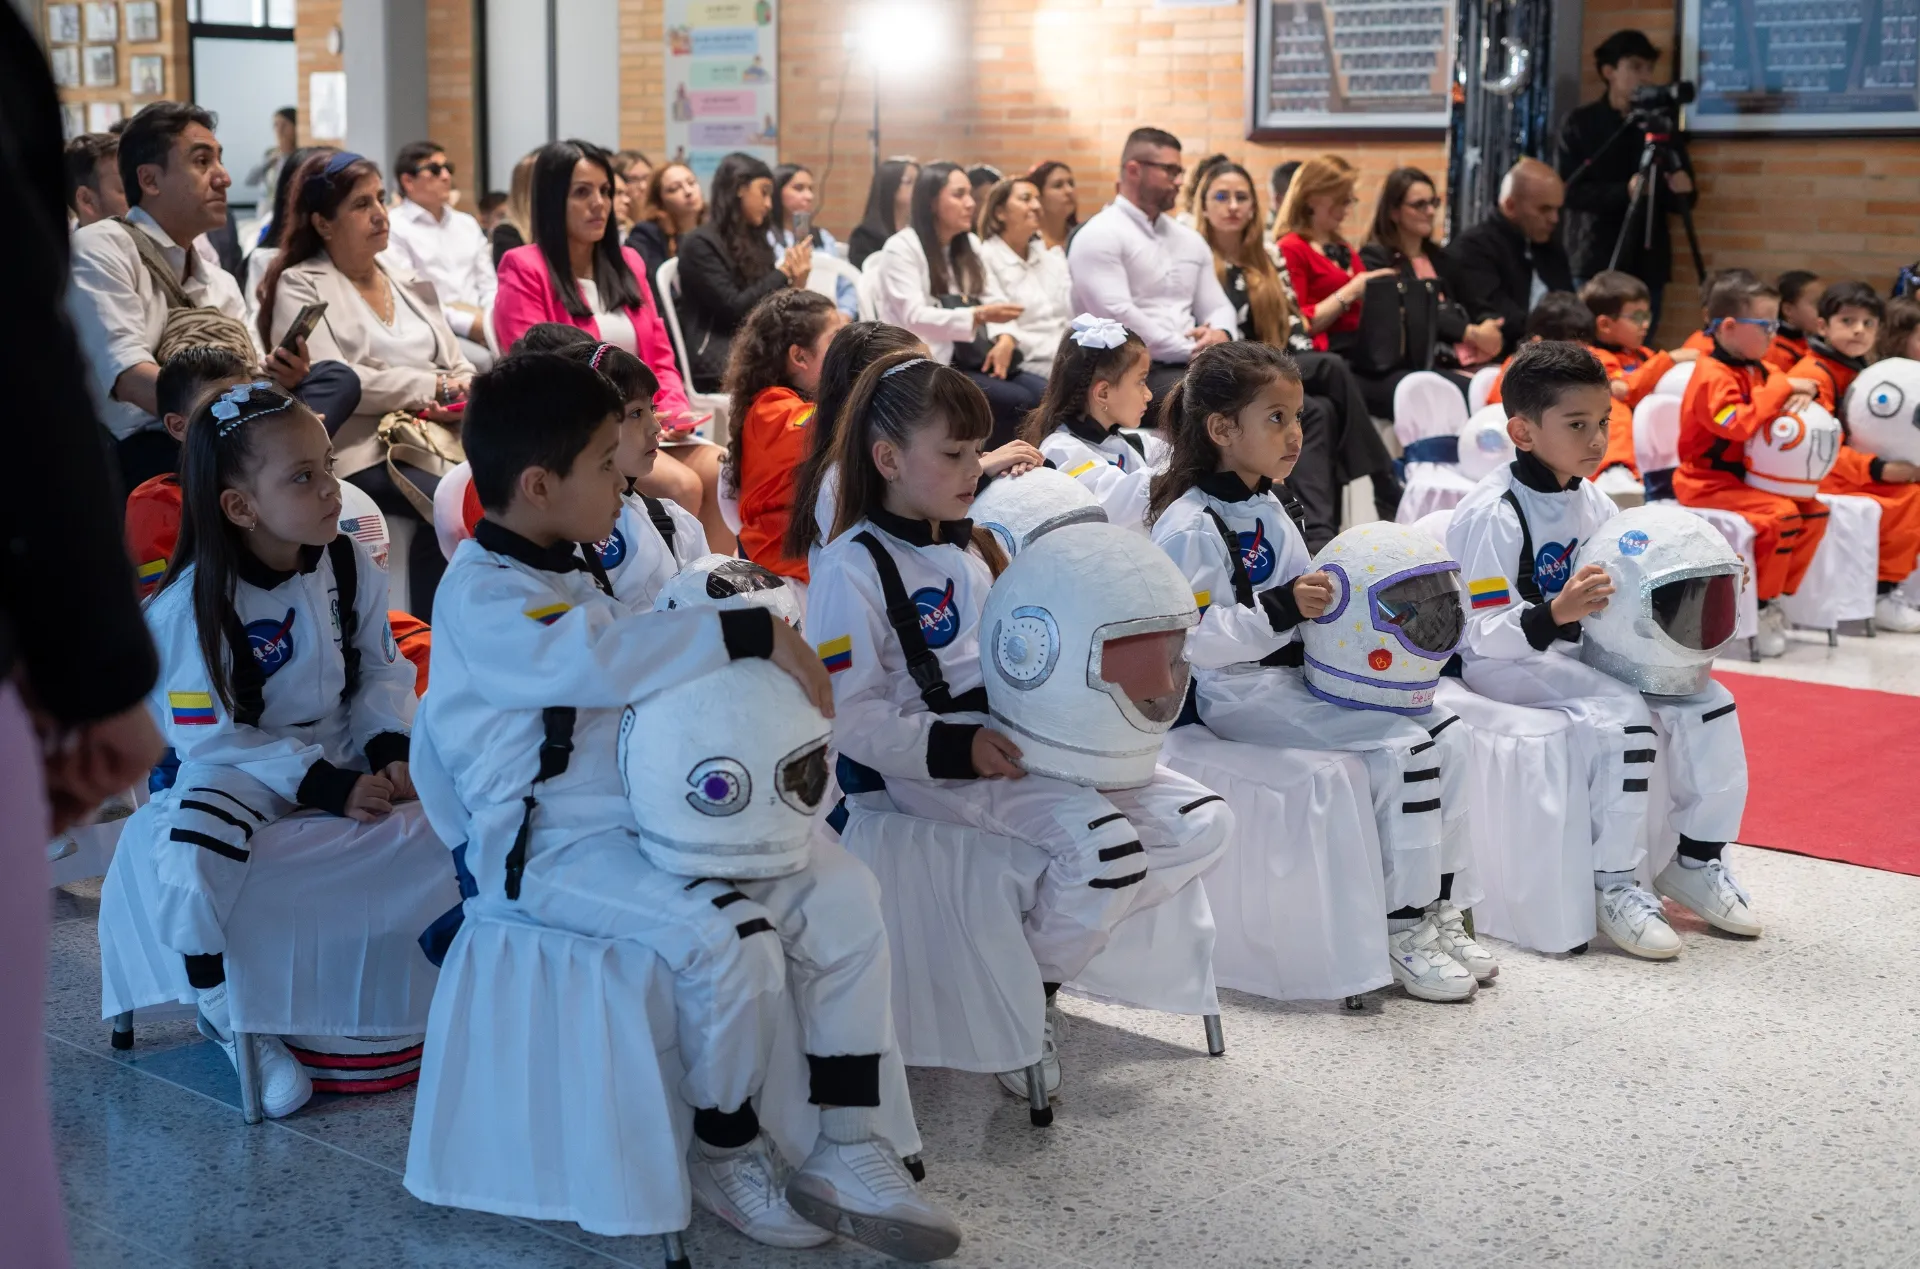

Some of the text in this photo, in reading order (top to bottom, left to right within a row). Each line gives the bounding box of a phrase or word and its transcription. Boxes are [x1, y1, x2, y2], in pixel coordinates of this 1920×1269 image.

[592, 534, 619, 554] ASA
[1619, 536, 1646, 550] NASA
[1241, 544, 1268, 569] ASA
[1538, 560, 1568, 577] NASA
[252, 638, 288, 660] ASA
[1375, 657, 1387, 669] B
